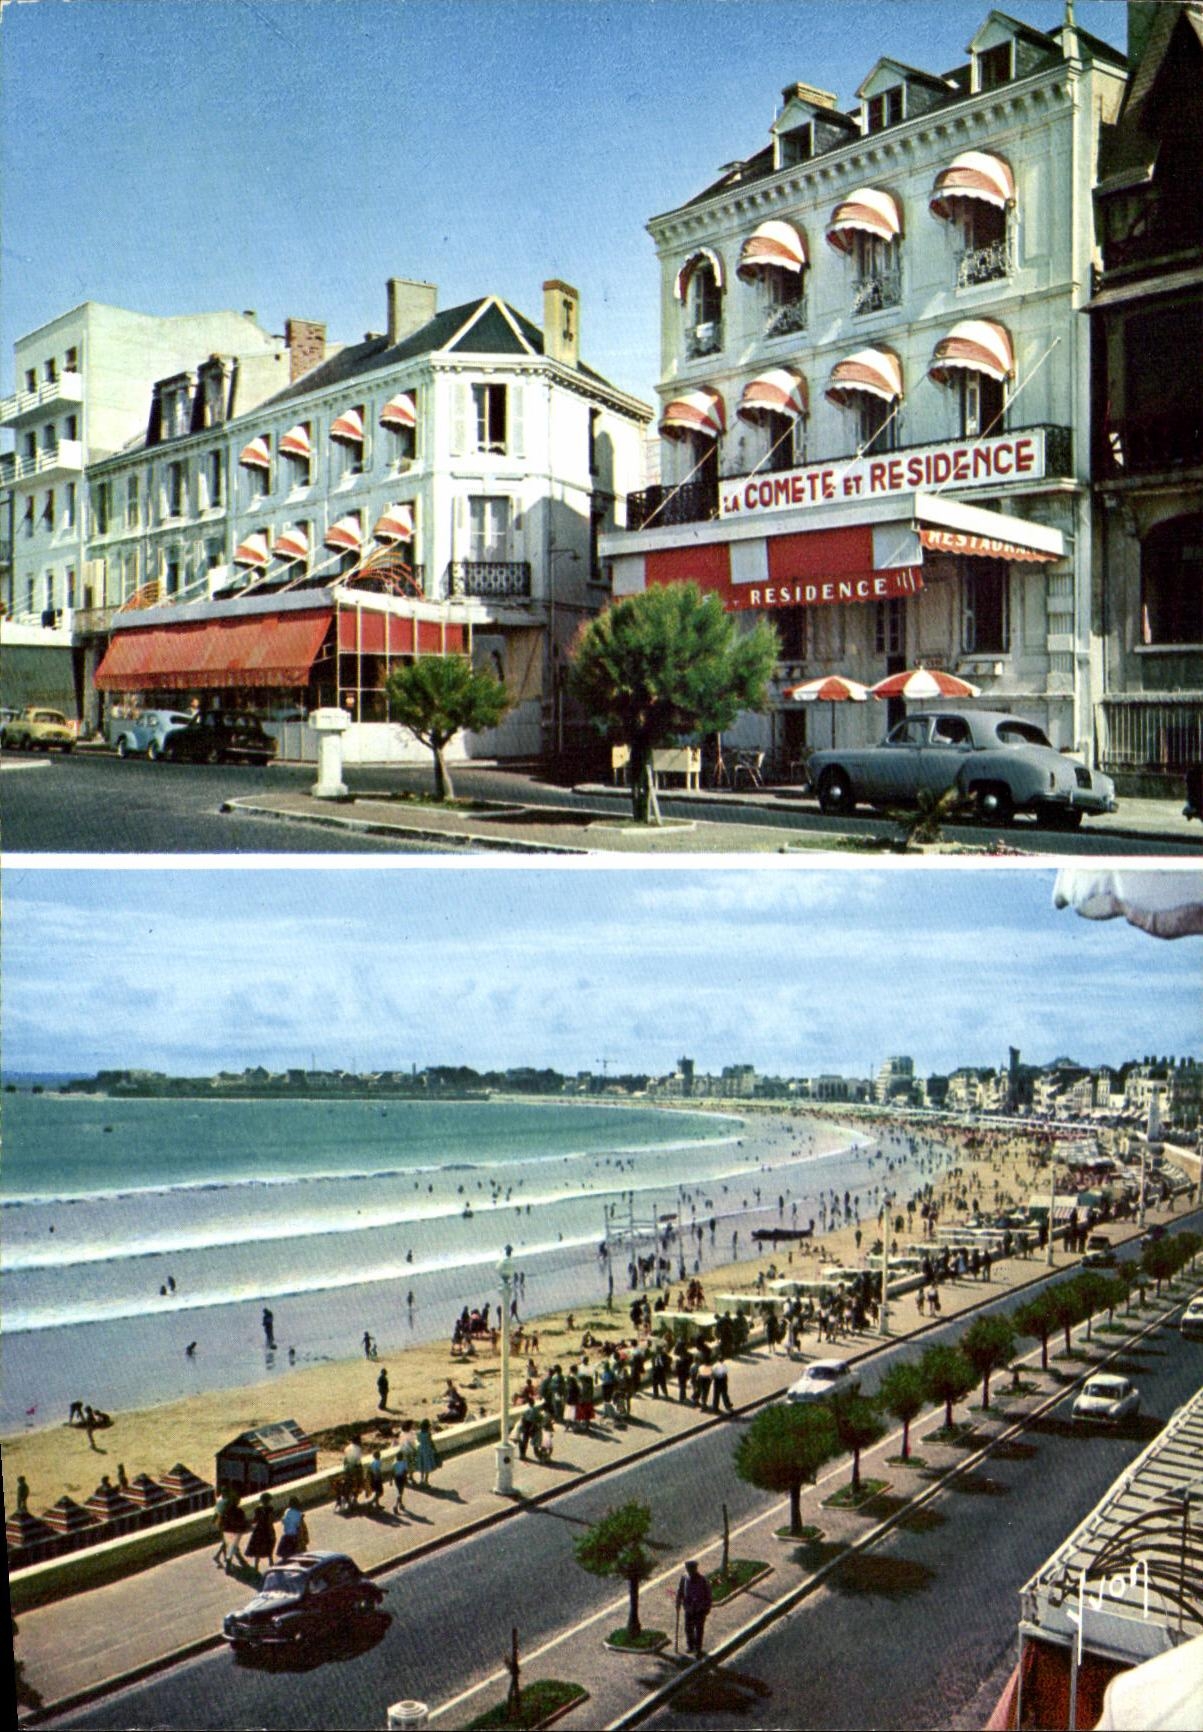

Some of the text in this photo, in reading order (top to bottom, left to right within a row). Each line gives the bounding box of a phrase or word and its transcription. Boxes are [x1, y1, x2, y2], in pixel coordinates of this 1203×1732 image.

[723, 438, 1035, 513] LA COMETE ET RESIDENCE
[750, 577, 888, 606] RESIDENCE
